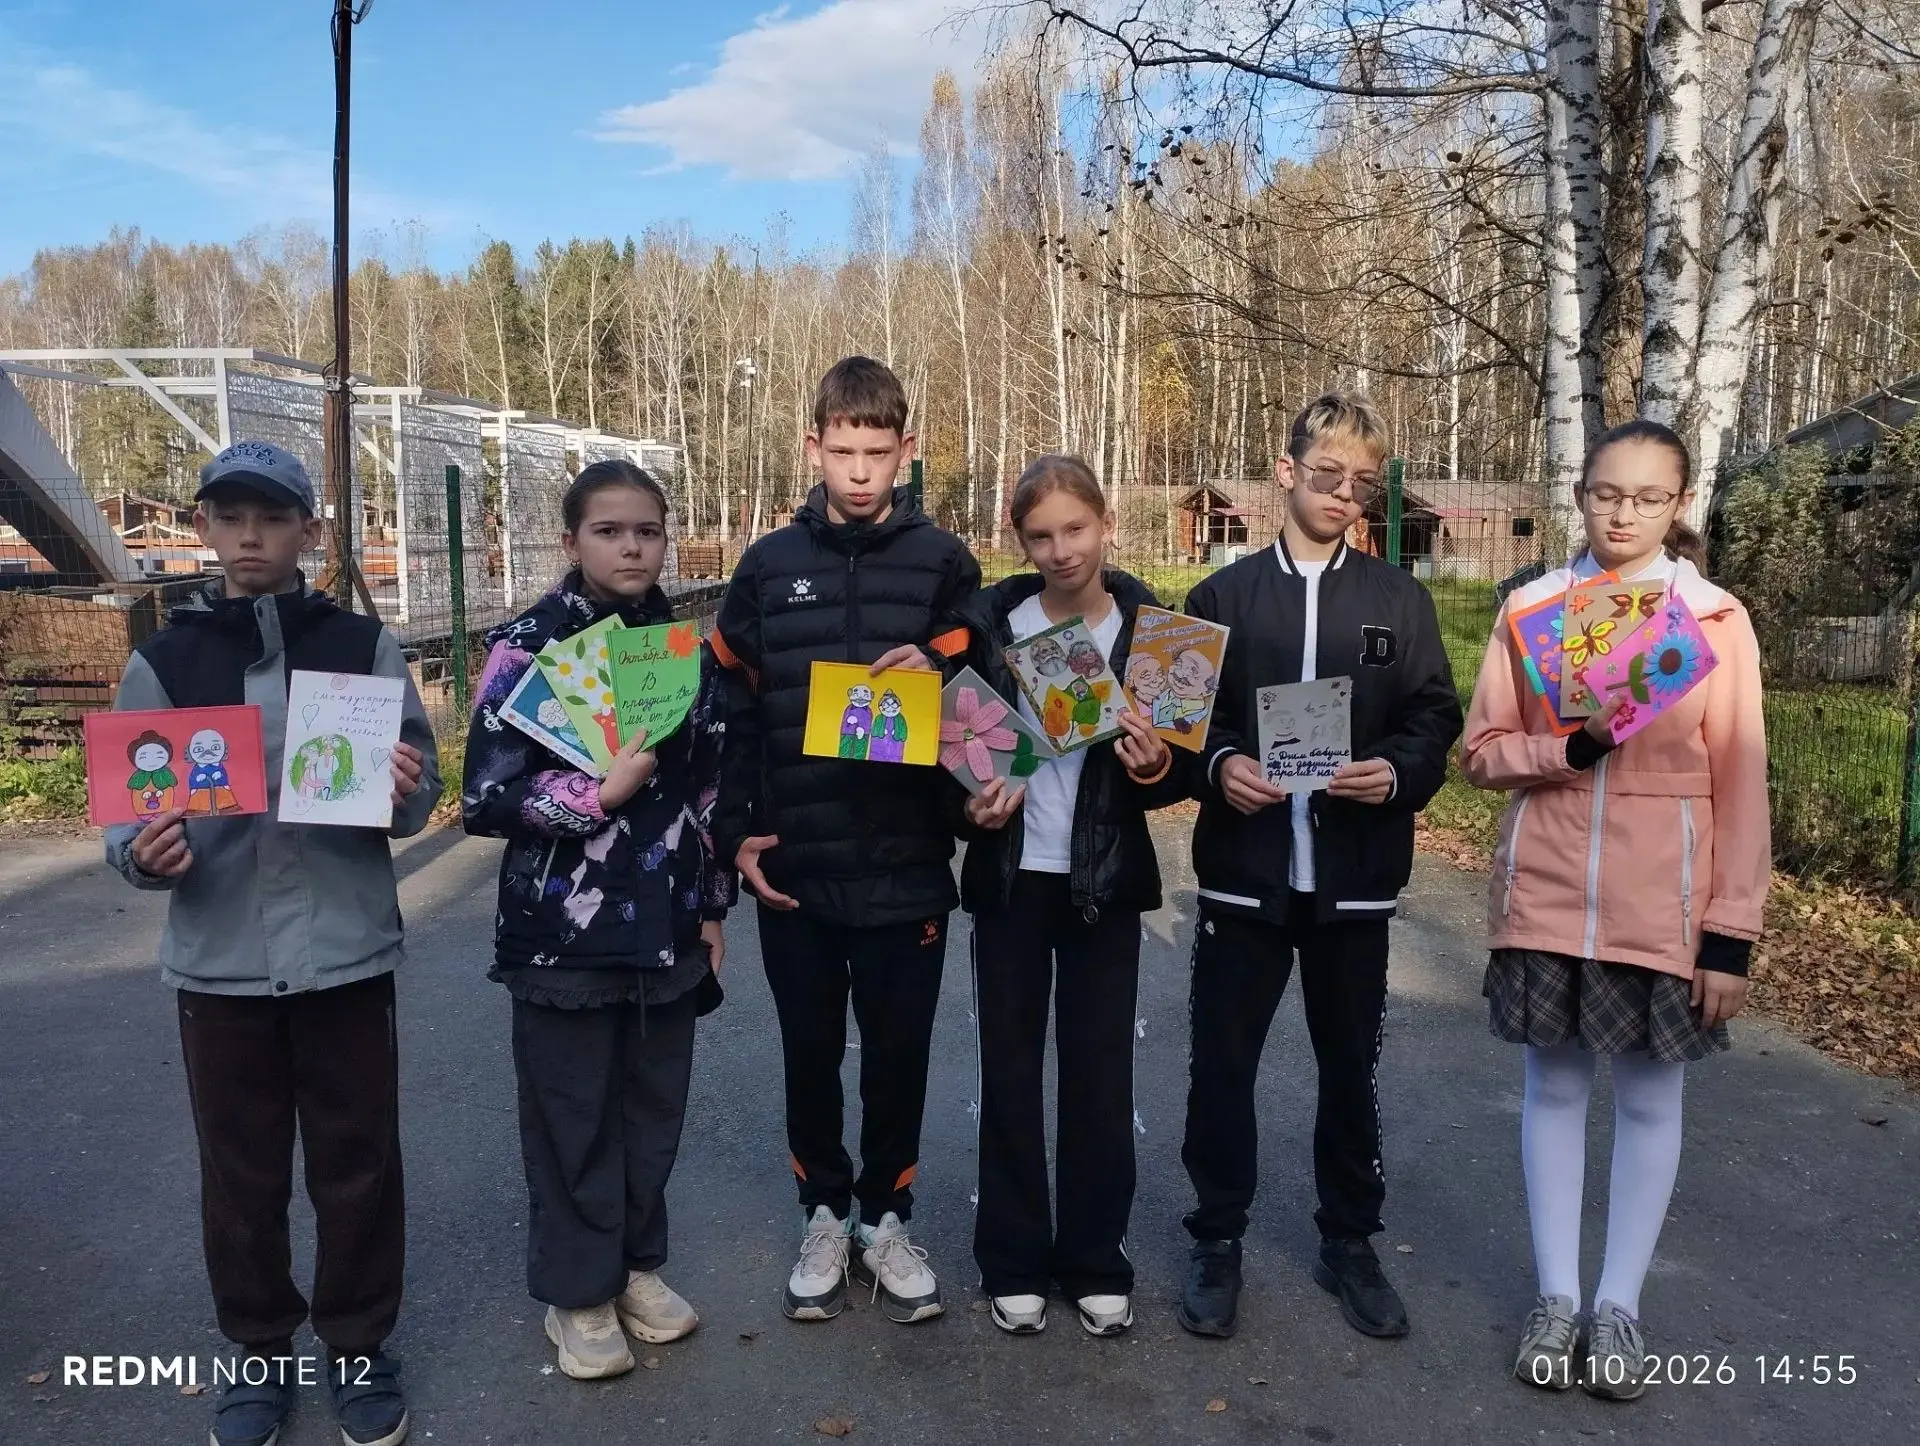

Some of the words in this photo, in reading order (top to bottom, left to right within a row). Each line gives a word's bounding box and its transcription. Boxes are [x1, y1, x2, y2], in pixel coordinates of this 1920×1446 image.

[221, 449, 277, 466] RULES
[228, 443, 273, 456] YOUR
[641, 632, 651, 647] 1
[1360, 625, 1398, 668] D
[641, 671, 657, 691] В
[1267, 752, 1275, 760] С
